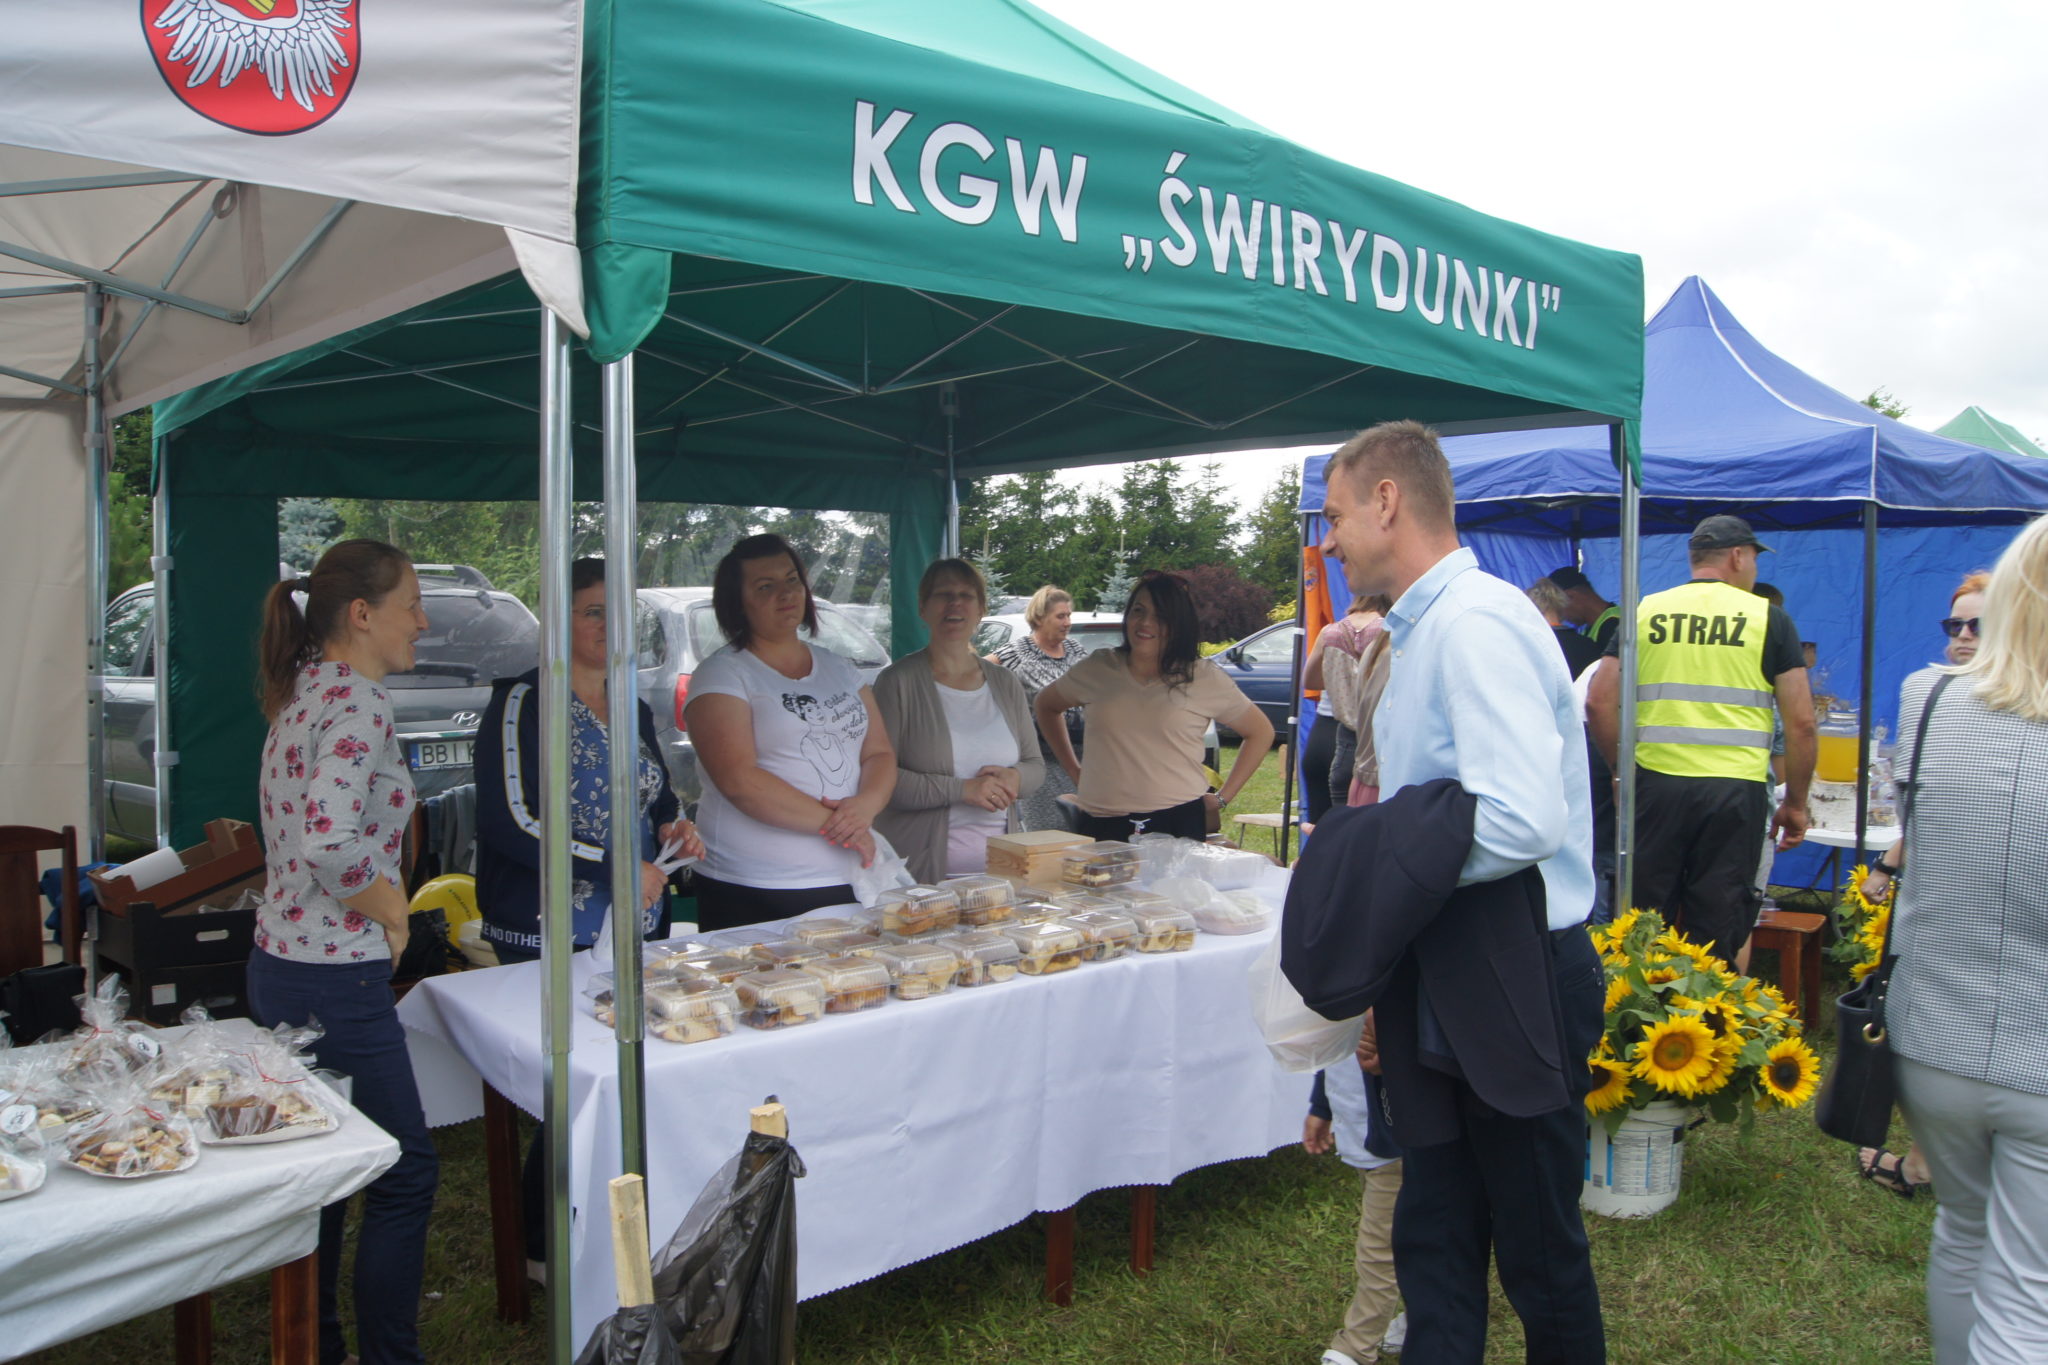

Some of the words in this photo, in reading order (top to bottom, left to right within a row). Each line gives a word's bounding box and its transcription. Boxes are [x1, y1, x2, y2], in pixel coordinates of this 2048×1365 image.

[851, 99, 1088, 243] KGW
[1648, 611, 1748, 647] STRAŻ
[505, 931, 541, 947] OTHE
